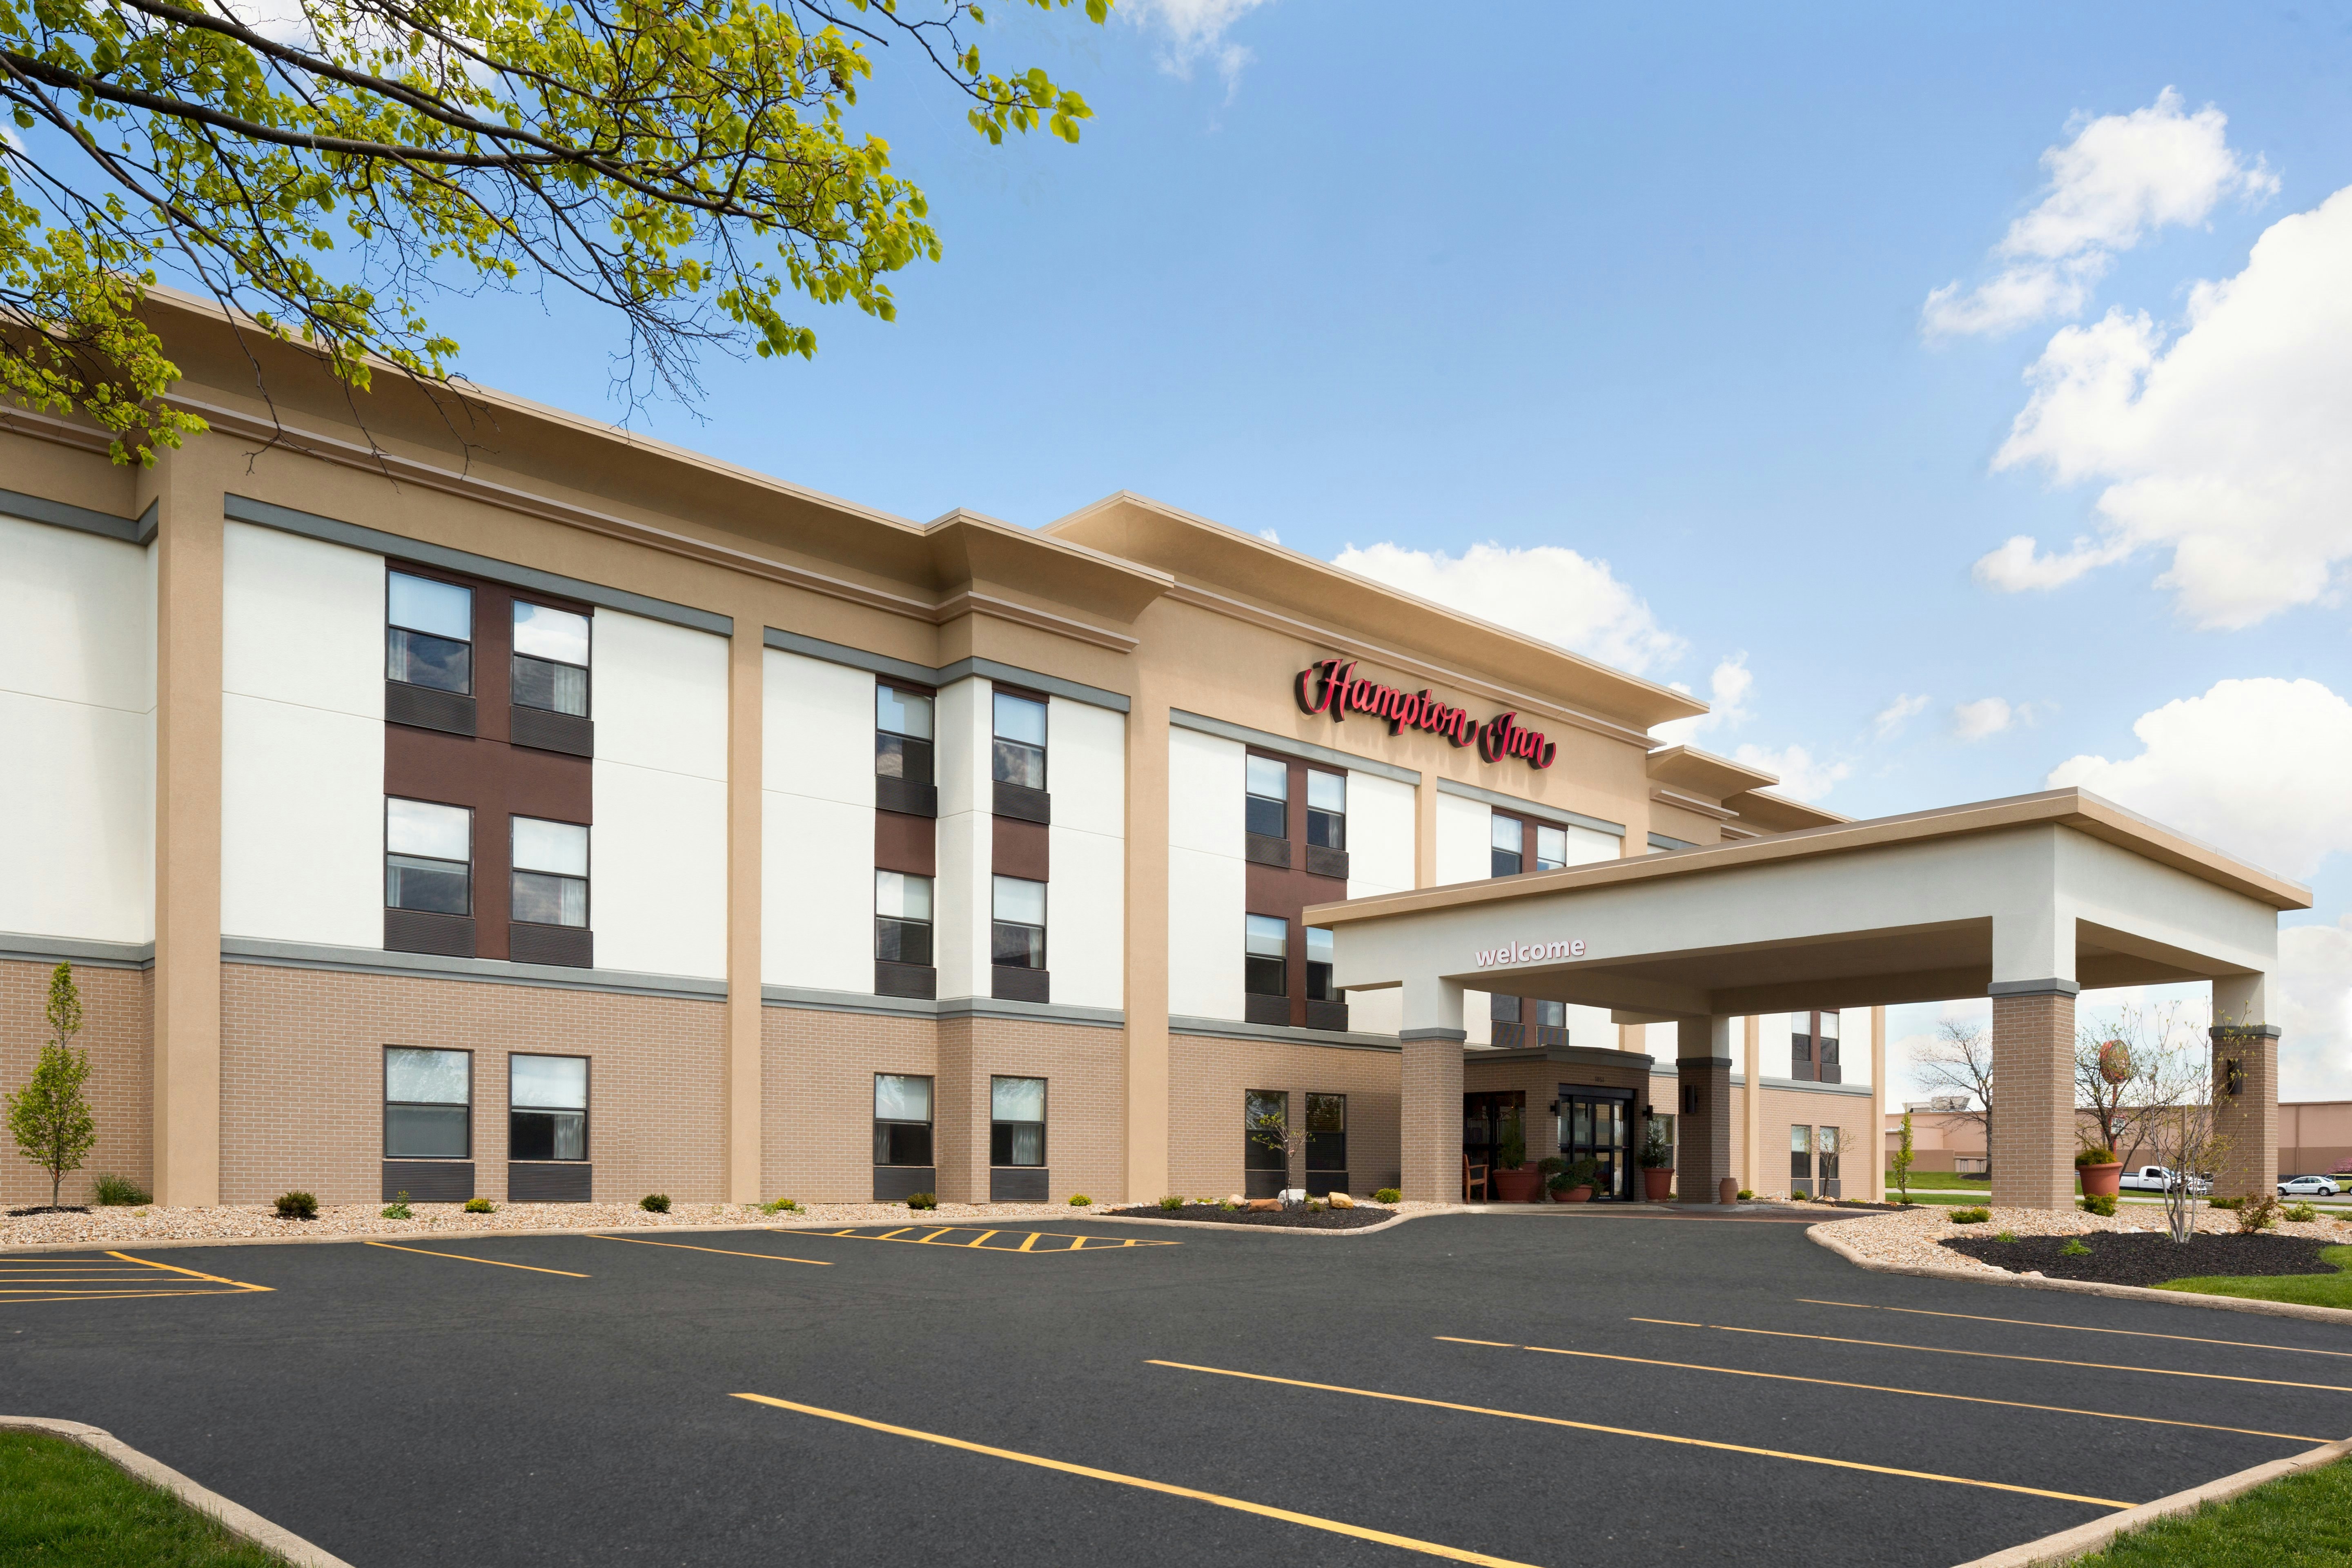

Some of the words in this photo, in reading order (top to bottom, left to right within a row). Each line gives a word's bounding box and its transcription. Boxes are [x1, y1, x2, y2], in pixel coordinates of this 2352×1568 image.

[1297, 658, 1479, 748] Hampton
[1480, 712, 1557, 769] Inn
[1475, 939, 1586, 967] welcome
